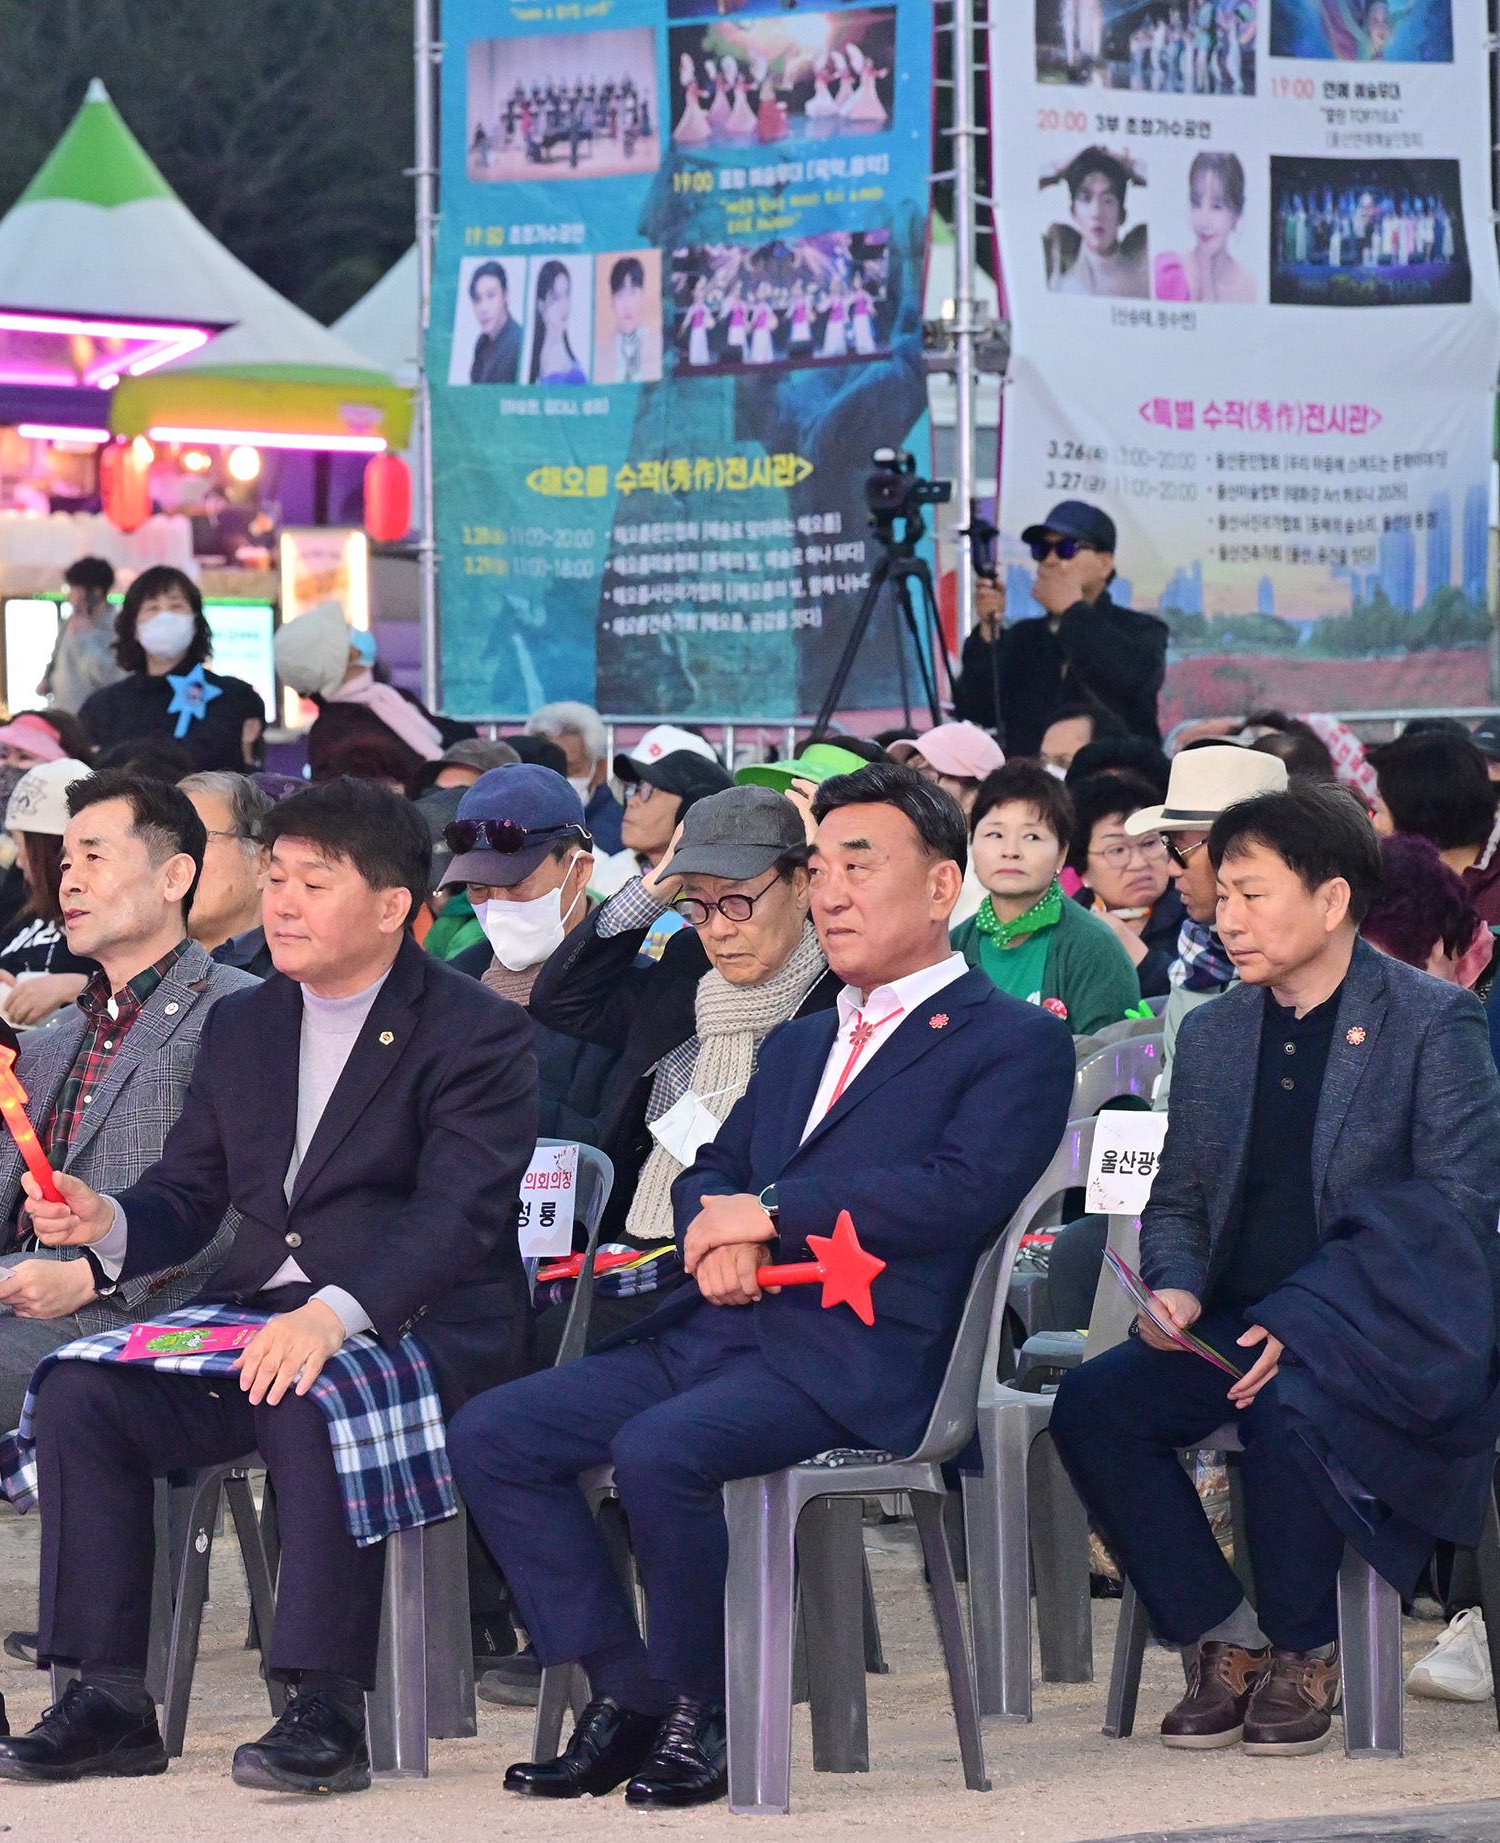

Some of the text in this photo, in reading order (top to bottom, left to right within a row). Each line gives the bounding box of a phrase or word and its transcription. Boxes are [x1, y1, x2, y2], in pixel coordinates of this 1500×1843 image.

[1036, 108, 1212, 140] 20:00 3부 초청가수공연
[1139, 397, 1384, 435] <특별 수작(秀作)전시관>
[526, 452, 814, 498] <해오름 수작(秀作)전시관>
[1101, 1149, 1160, 1176] 울산광
[524, 1170, 573, 1190] 의회의장
